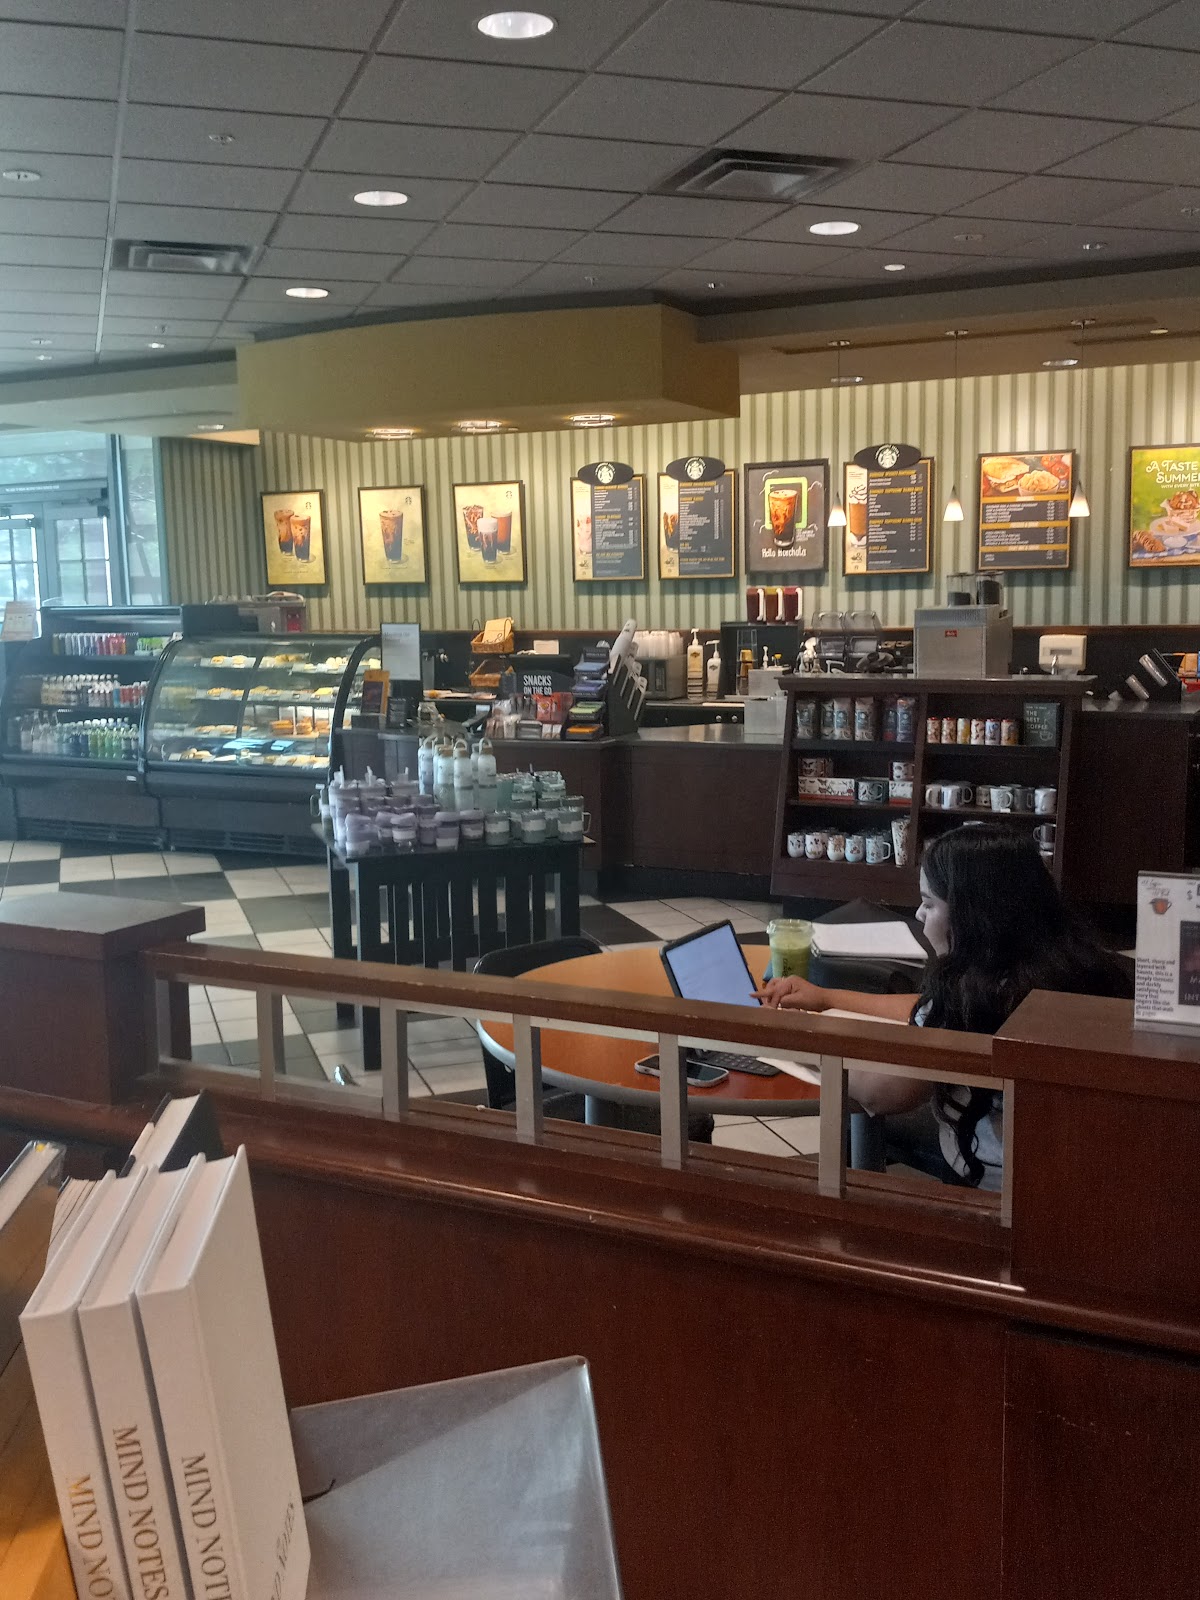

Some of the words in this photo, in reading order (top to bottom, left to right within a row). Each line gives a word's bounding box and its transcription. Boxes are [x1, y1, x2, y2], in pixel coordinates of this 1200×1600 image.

[1146, 461, 1160, 473] A
[1161, 460, 1198, 472] TASTE
[1156, 472, 1200, 483] SUMME
[523, 674, 552, 686] SNACKS
[523, 686, 532, 695] ON
[532, 686, 543, 695] THE
[543, 687, 552, 696] GO
[113, 1424, 150, 1502] MIND
[67, 1473, 104, 1551] MIND
[182, 1452, 218, 1529] MIND
[128, 1505, 170, 1600] NOTES
[83, 1554, 117, 1600] NO
